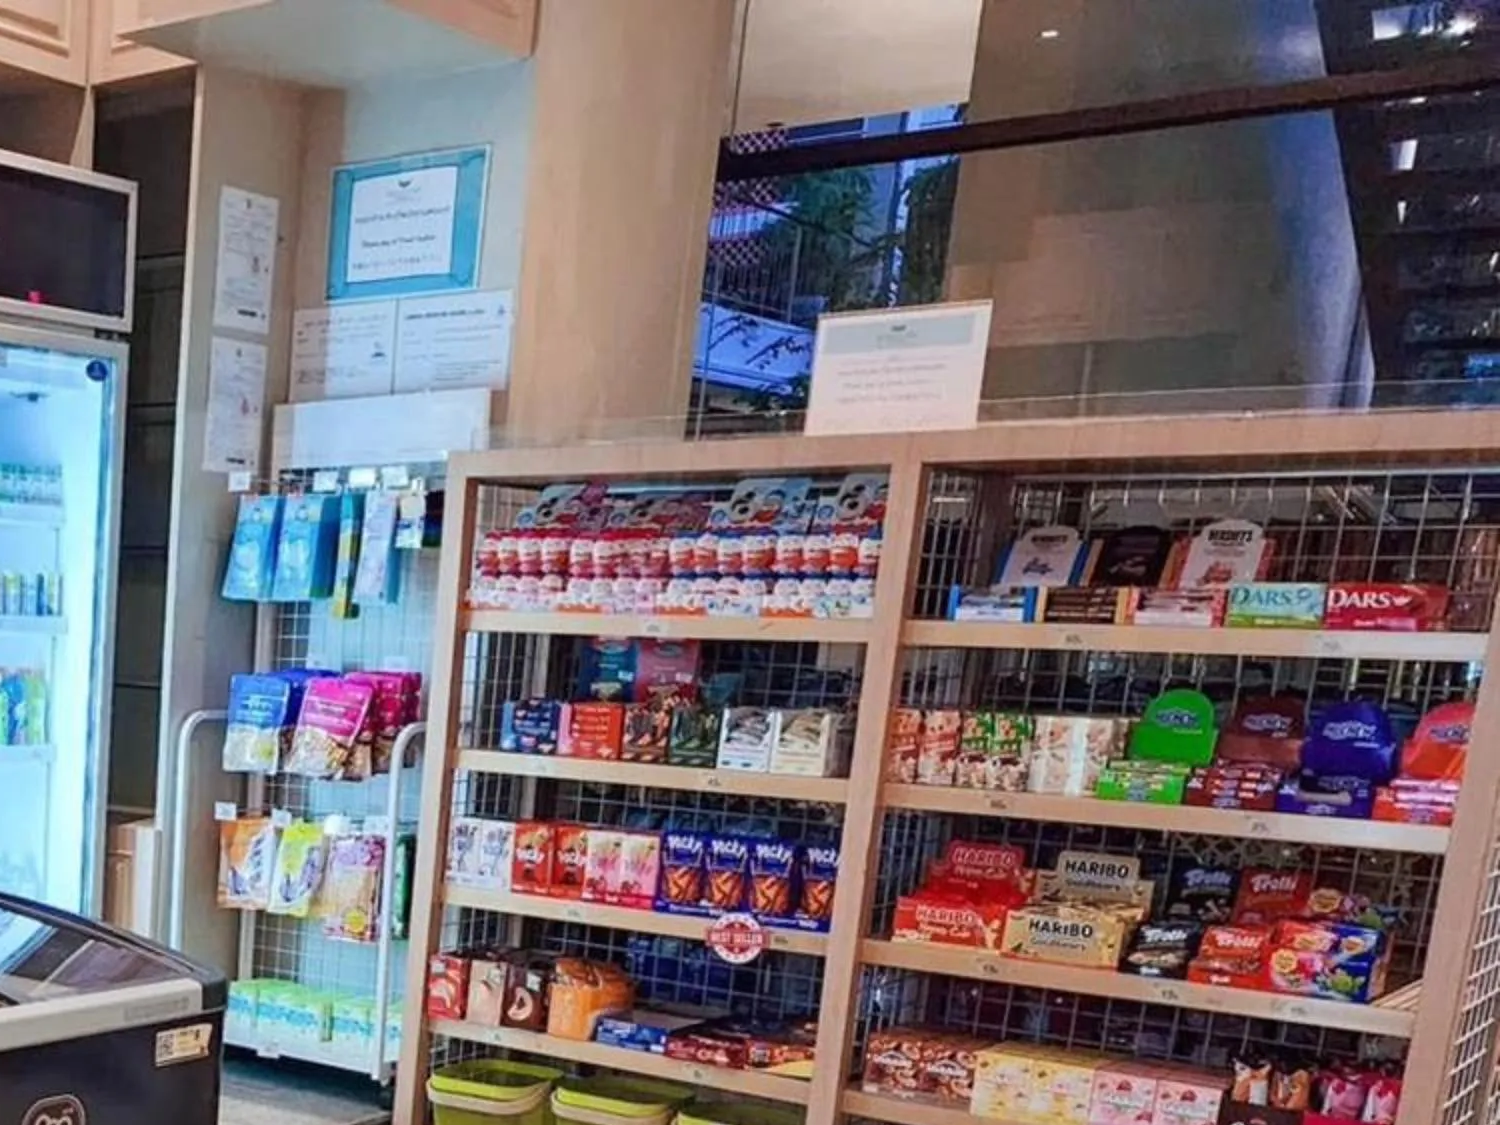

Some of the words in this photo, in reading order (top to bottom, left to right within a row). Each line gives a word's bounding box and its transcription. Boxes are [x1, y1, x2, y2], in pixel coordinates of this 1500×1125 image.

[1231, 586, 1294, 606] DARS
[1327, 588, 1392, 609] DARS
[952, 848, 1015, 867] HARIBO
[1064, 859, 1131, 879] HARIBO
[1251, 873, 1298, 893] Trolli
[915, 903, 977, 924] HARIBO
[1027, 917, 1094, 940] HARIBO
[1140, 925, 1189, 943] Trolli
[1215, 930, 1263, 949] Trolli
